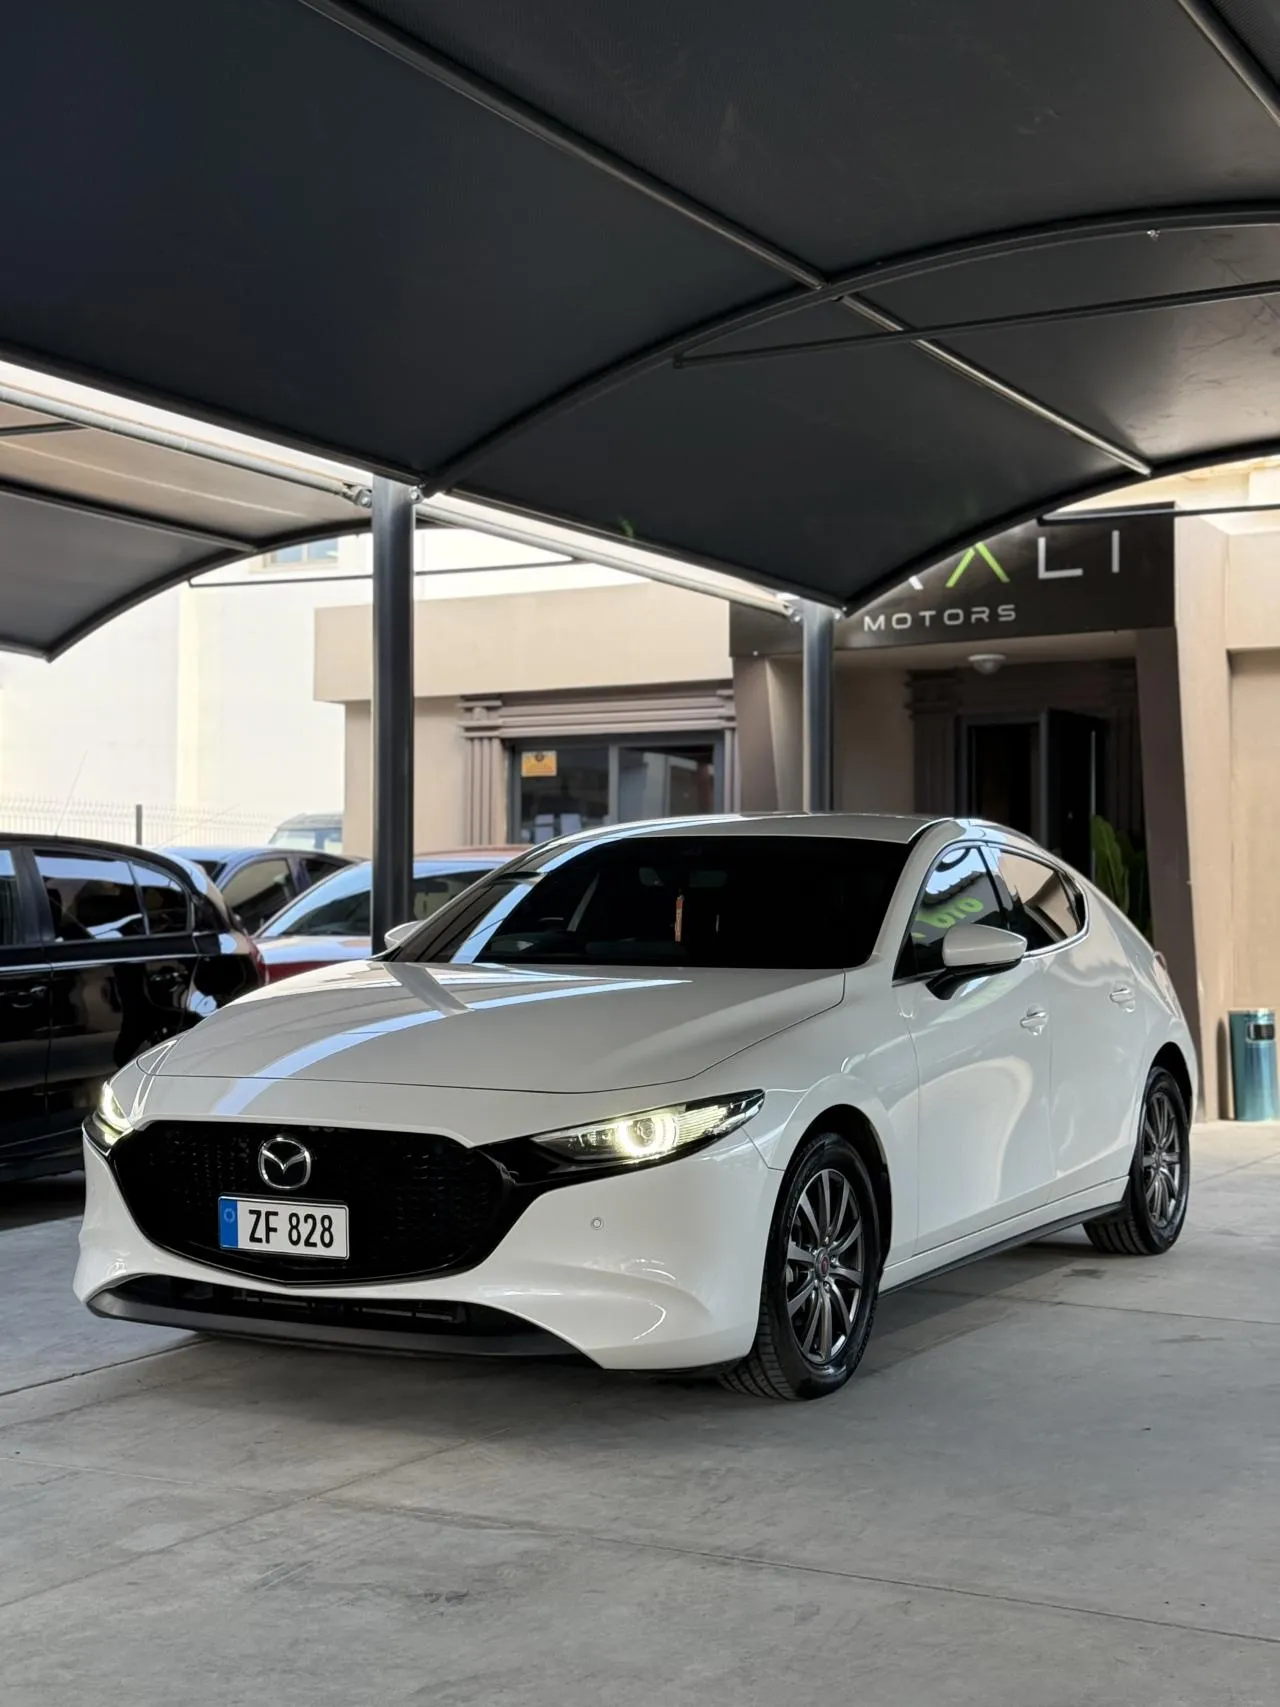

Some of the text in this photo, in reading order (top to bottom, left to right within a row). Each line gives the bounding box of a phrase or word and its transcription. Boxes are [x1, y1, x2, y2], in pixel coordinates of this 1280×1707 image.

[908, 530, 1120, 590] ALI
[863, 604, 1016, 632] MOTORS
[248, 1209, 334, 1249] ZF 828
